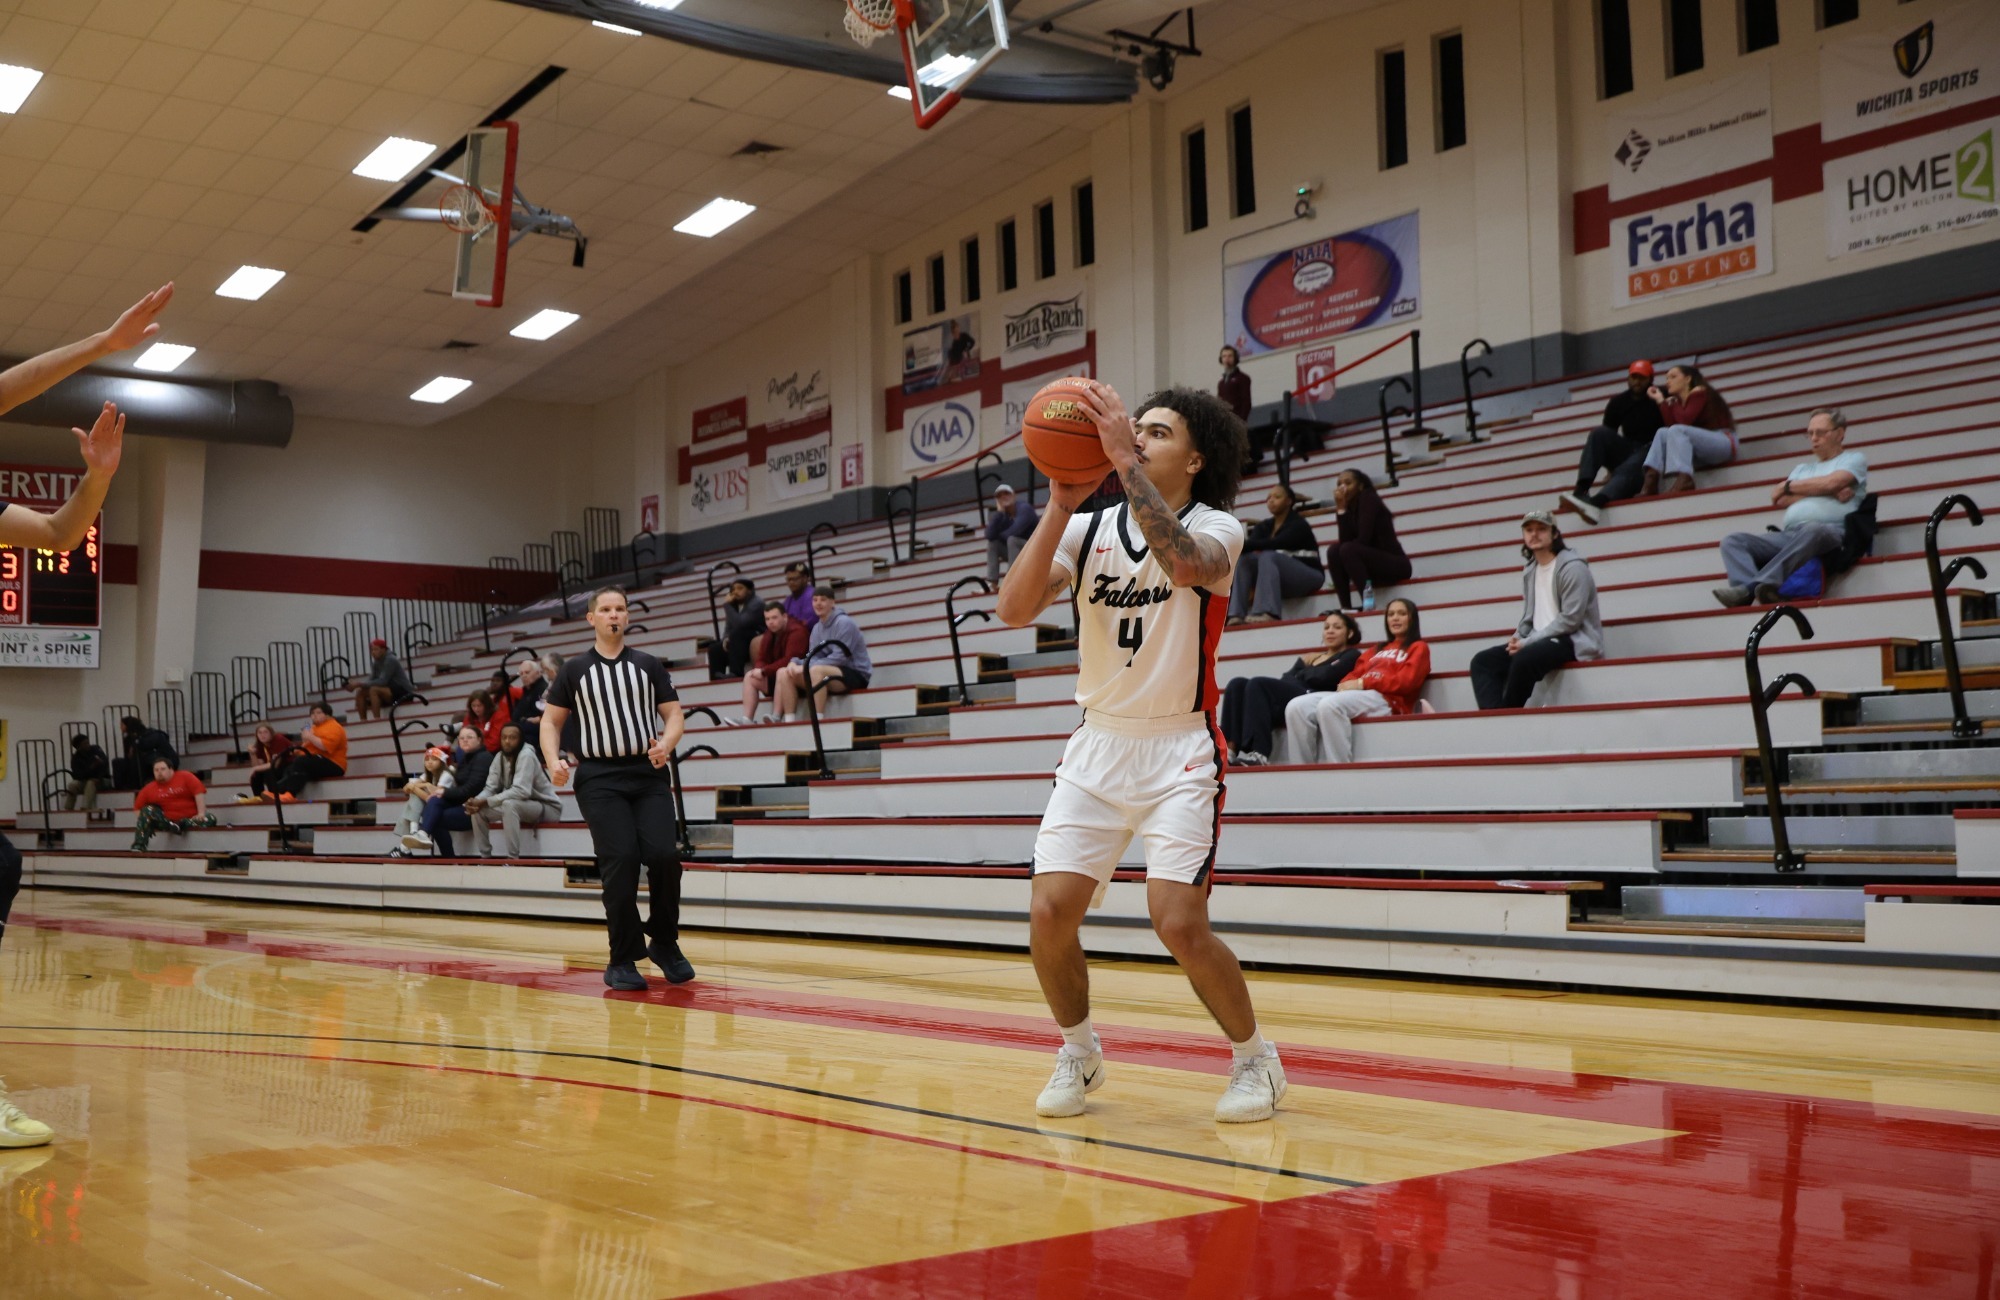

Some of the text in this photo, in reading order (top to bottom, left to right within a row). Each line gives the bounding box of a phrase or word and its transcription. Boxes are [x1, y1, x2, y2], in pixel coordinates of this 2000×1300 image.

[1857, 88, 1913, 117] WICHITA
[1919, 69, 1979, 99] SPORTS
[1740, 108, 1767, 122] Clinic
[1850, 193, 1953, 223] SUITES BY HILTON
[1628, 201, 1755, 267] Farha
[1875, 228, 1917, 245] Sycamore
[1293, 240, 1333, 268] NAIA
[1633, 251, 1751, 292] ROOFING
[1006, 300, 1083, 347] Pizza Ranch
[921, 416, 963, 447] IMA
[768, 444, 827, 473] SUPPLEMENT
[714, 466, 748, 501] UBS
[3, 553, 18, 579] 3
[3, 590, 17, 612] 0
[1089, 573, 1173, 608] Falcons
[44, 643, 92, 655] SPINE
[1118, 617, 1143, 668] 4
